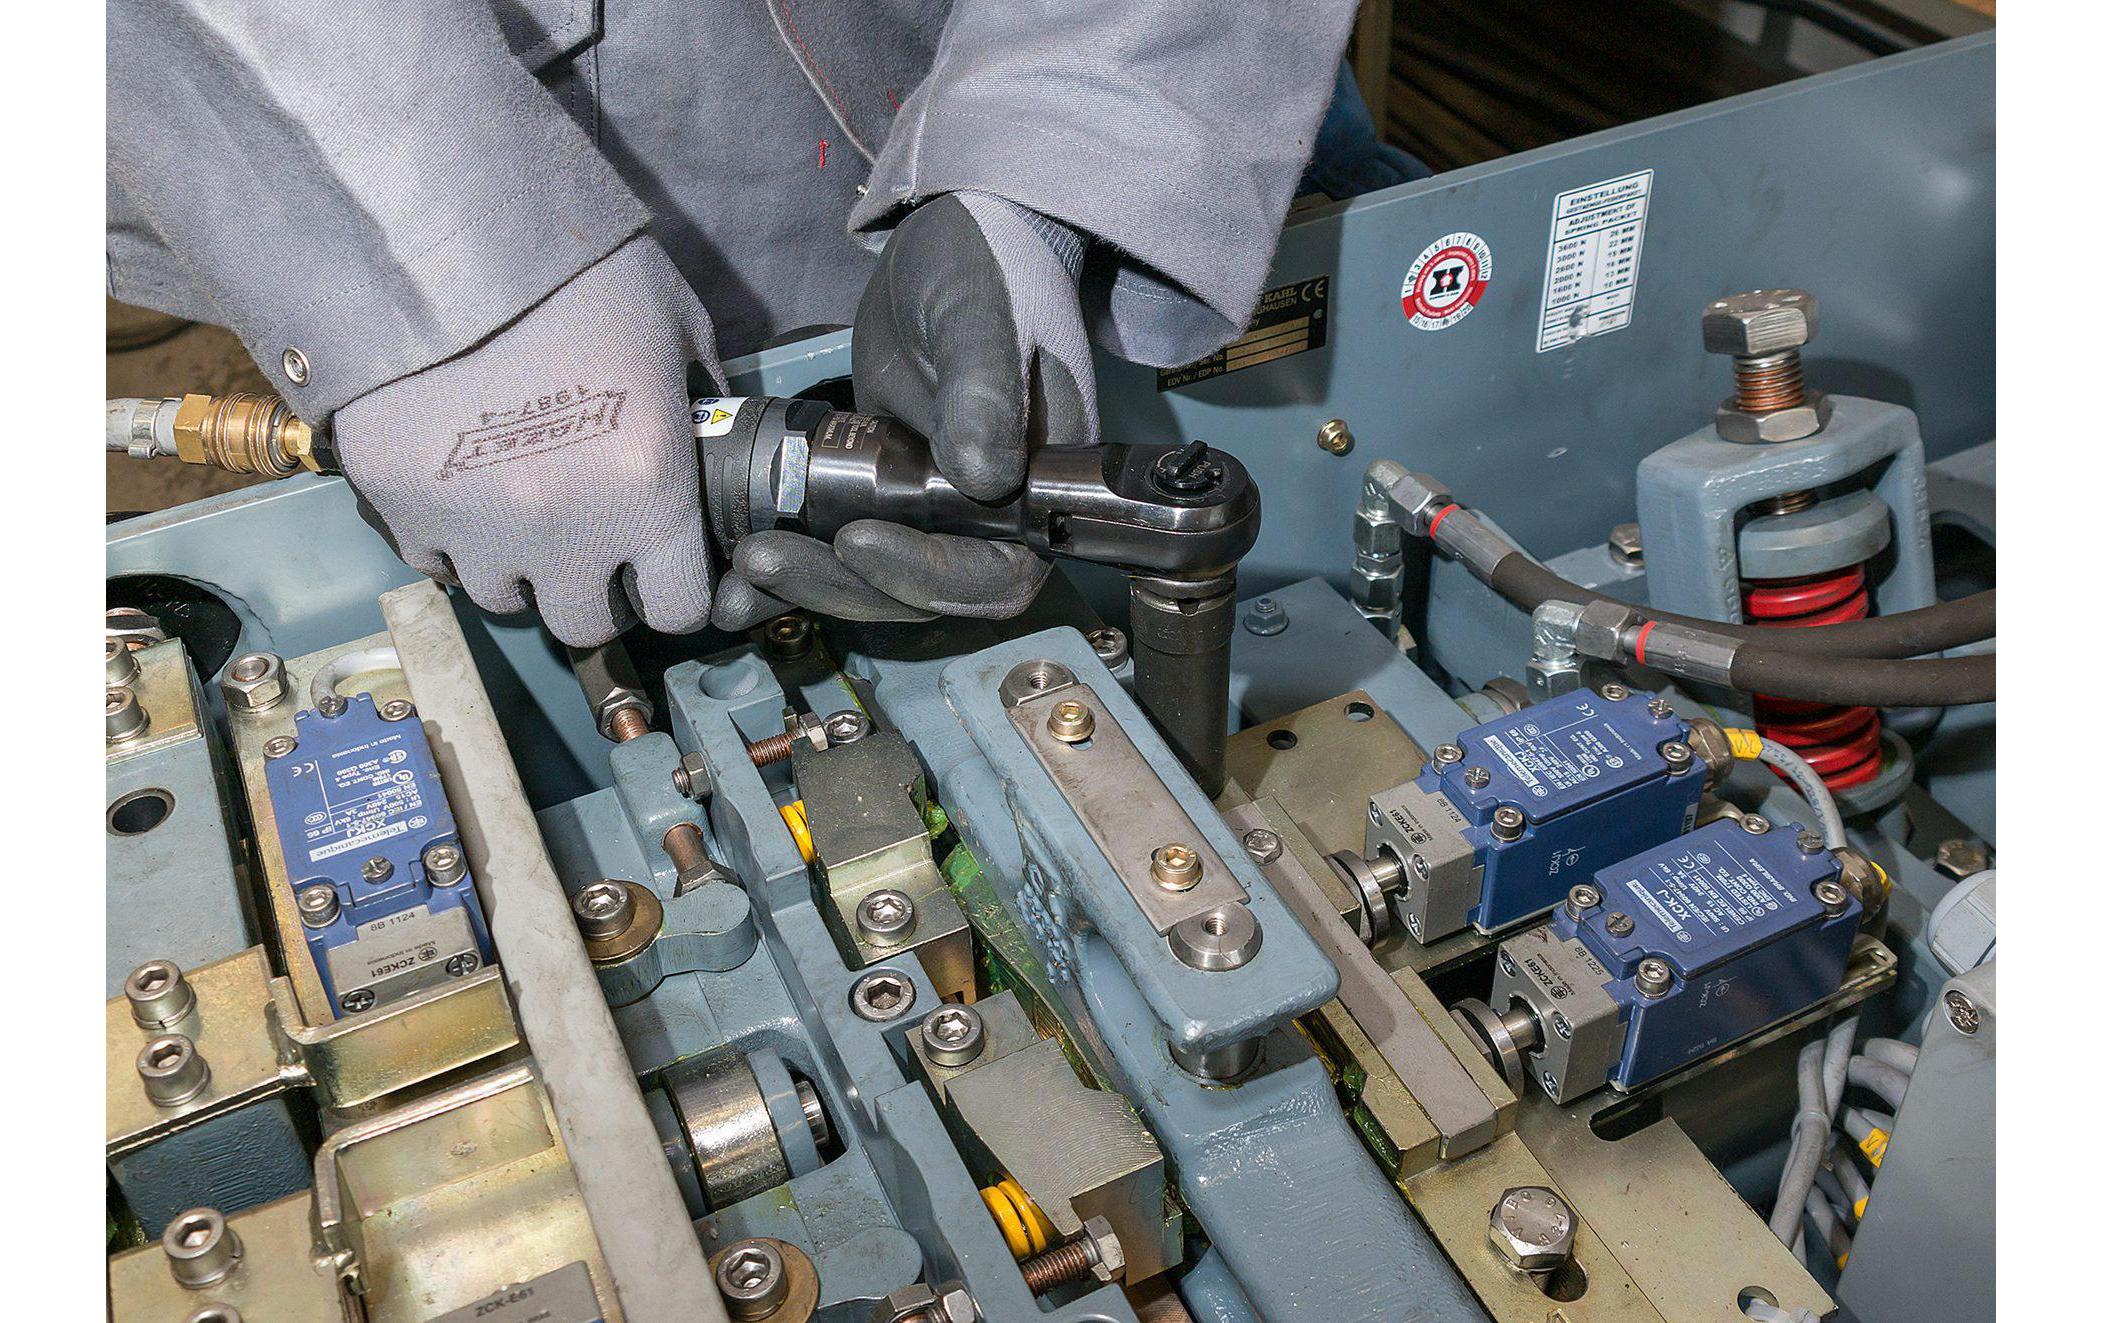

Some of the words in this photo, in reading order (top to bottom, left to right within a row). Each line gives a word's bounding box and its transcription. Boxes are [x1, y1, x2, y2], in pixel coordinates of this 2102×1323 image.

[1570, 181, 1639, 205] EINSTELLUNG
[1564, 221, 1598, 235] SPRING
[1602, 210, 1636, 224] PACKET
[1569, 206, 1623, 226] ADJUSTMENT
[1264, 287, 1297, 303] KAHL
[1168, 378, 1181, 387] EDV
[1199, 368, 1212, 378] EDP
[1189, 460, 1211, 478] PUSH
[1513, 750, 1540, 772] XCKJ
[403, 781, 416, 790] EN
[345, 818, 385, 838] XCKJ
[1389, 809, 1414, 833] ZCKE61
[315, 823, 401, 859] Telemecanique
[1655, 888, 1692, 920] XCK-J
[390, 912, 416, 925] 1124
[371, 957, 416, 978] ZCKE61
[1524, 958, 1553, 987] ZCKE61
[1585, 957, 1605, 976] 1225
